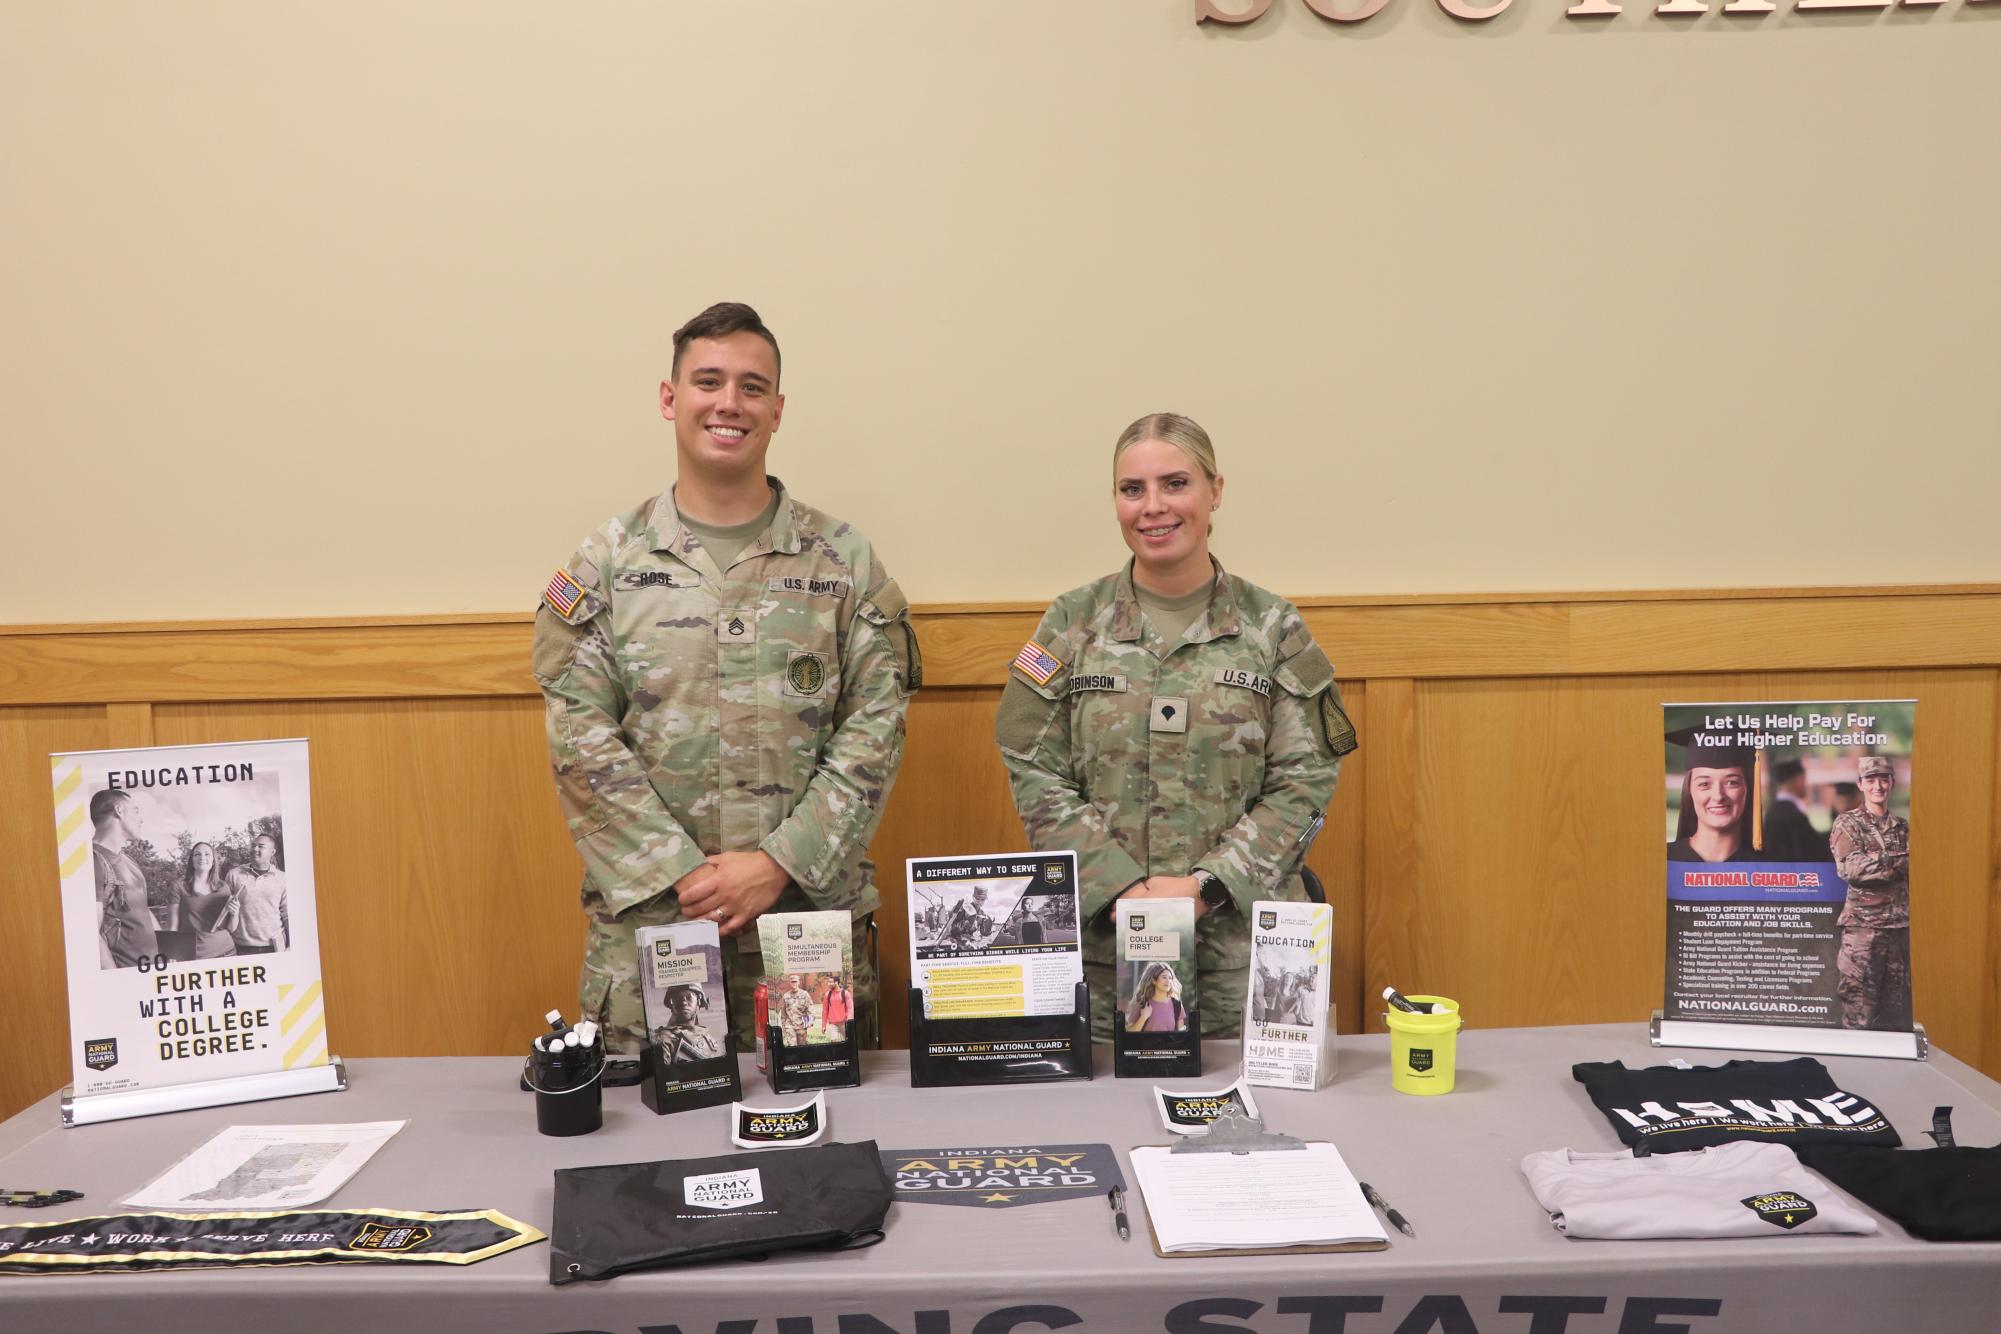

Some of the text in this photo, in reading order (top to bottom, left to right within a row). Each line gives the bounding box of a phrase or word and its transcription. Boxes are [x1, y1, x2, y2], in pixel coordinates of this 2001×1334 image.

[640, 572, 673, 586] ROSE
[808, 581, 839, 593] ARMY
[1070, 675, 1115, 691] OBINSON
[1250, 675, 1273, 694] AR
[1705, 713, 1875, 732] Let Us Help Pay For
[1693, 731, 1888, 750] Your Higher Education
[108, 763, 254, 790] EDUCATION
[916, 864, 1037, 878] A DIFFERENT WAY TO SERVE
[1684, 872, 1799, 887] NATIONAL GUARD
[1130, 935, 1164, 943] COLLEGE
[1255, 935, 1315, 949] EDUCATION
[787, 943, 837, 951] SIMULTANEOUS
[787, 949, 831, 957] MEMBERSHIP
[137, 953, 168, 973] GO
[657, 958, 693, 969] MISSION
[156, 966, 266, 994] FURTHER
[140, 991, 237, 1019] WITH A
[1678, 1000, 1828, 1014] NATIONALGUARD.com
[158, 1009, 270, 1039] COLLEGE
[1261, 1029, 1308, 1042] FURTHER
[88, 1044, 113, 1053] ARMY
[160, 1033, 268, 1061] DEGREE.
[929, 1041, 1063, 1054] INDIANA ARMY NATIONAL GUARD
[88, 1054, 115, 1063] GUARD
[682, 1080, 708, 1090] NATIONAL
[708, 1077, 726, 1085] GUARD
[751, 1112, 808, 1124] ARMY
[939, 1148, 1042, 1157] INDIANA
[897, 1155, 1085, 1172] ARMY
[896, 1166, 1093, 1179] NATIONAL
[694, 1179, 750, 1192] ARMY
[894, 1174, 1097, 1190] GUARD
[693, 1187, 753, 1196] NATIONAL
[694, 1192, 754, 1202] GUARD
[1760, 1201, 1808, 1211] GUARD
[0, 1241, 15, 1251] E
[106, 1233, 171, 1245] WORK
